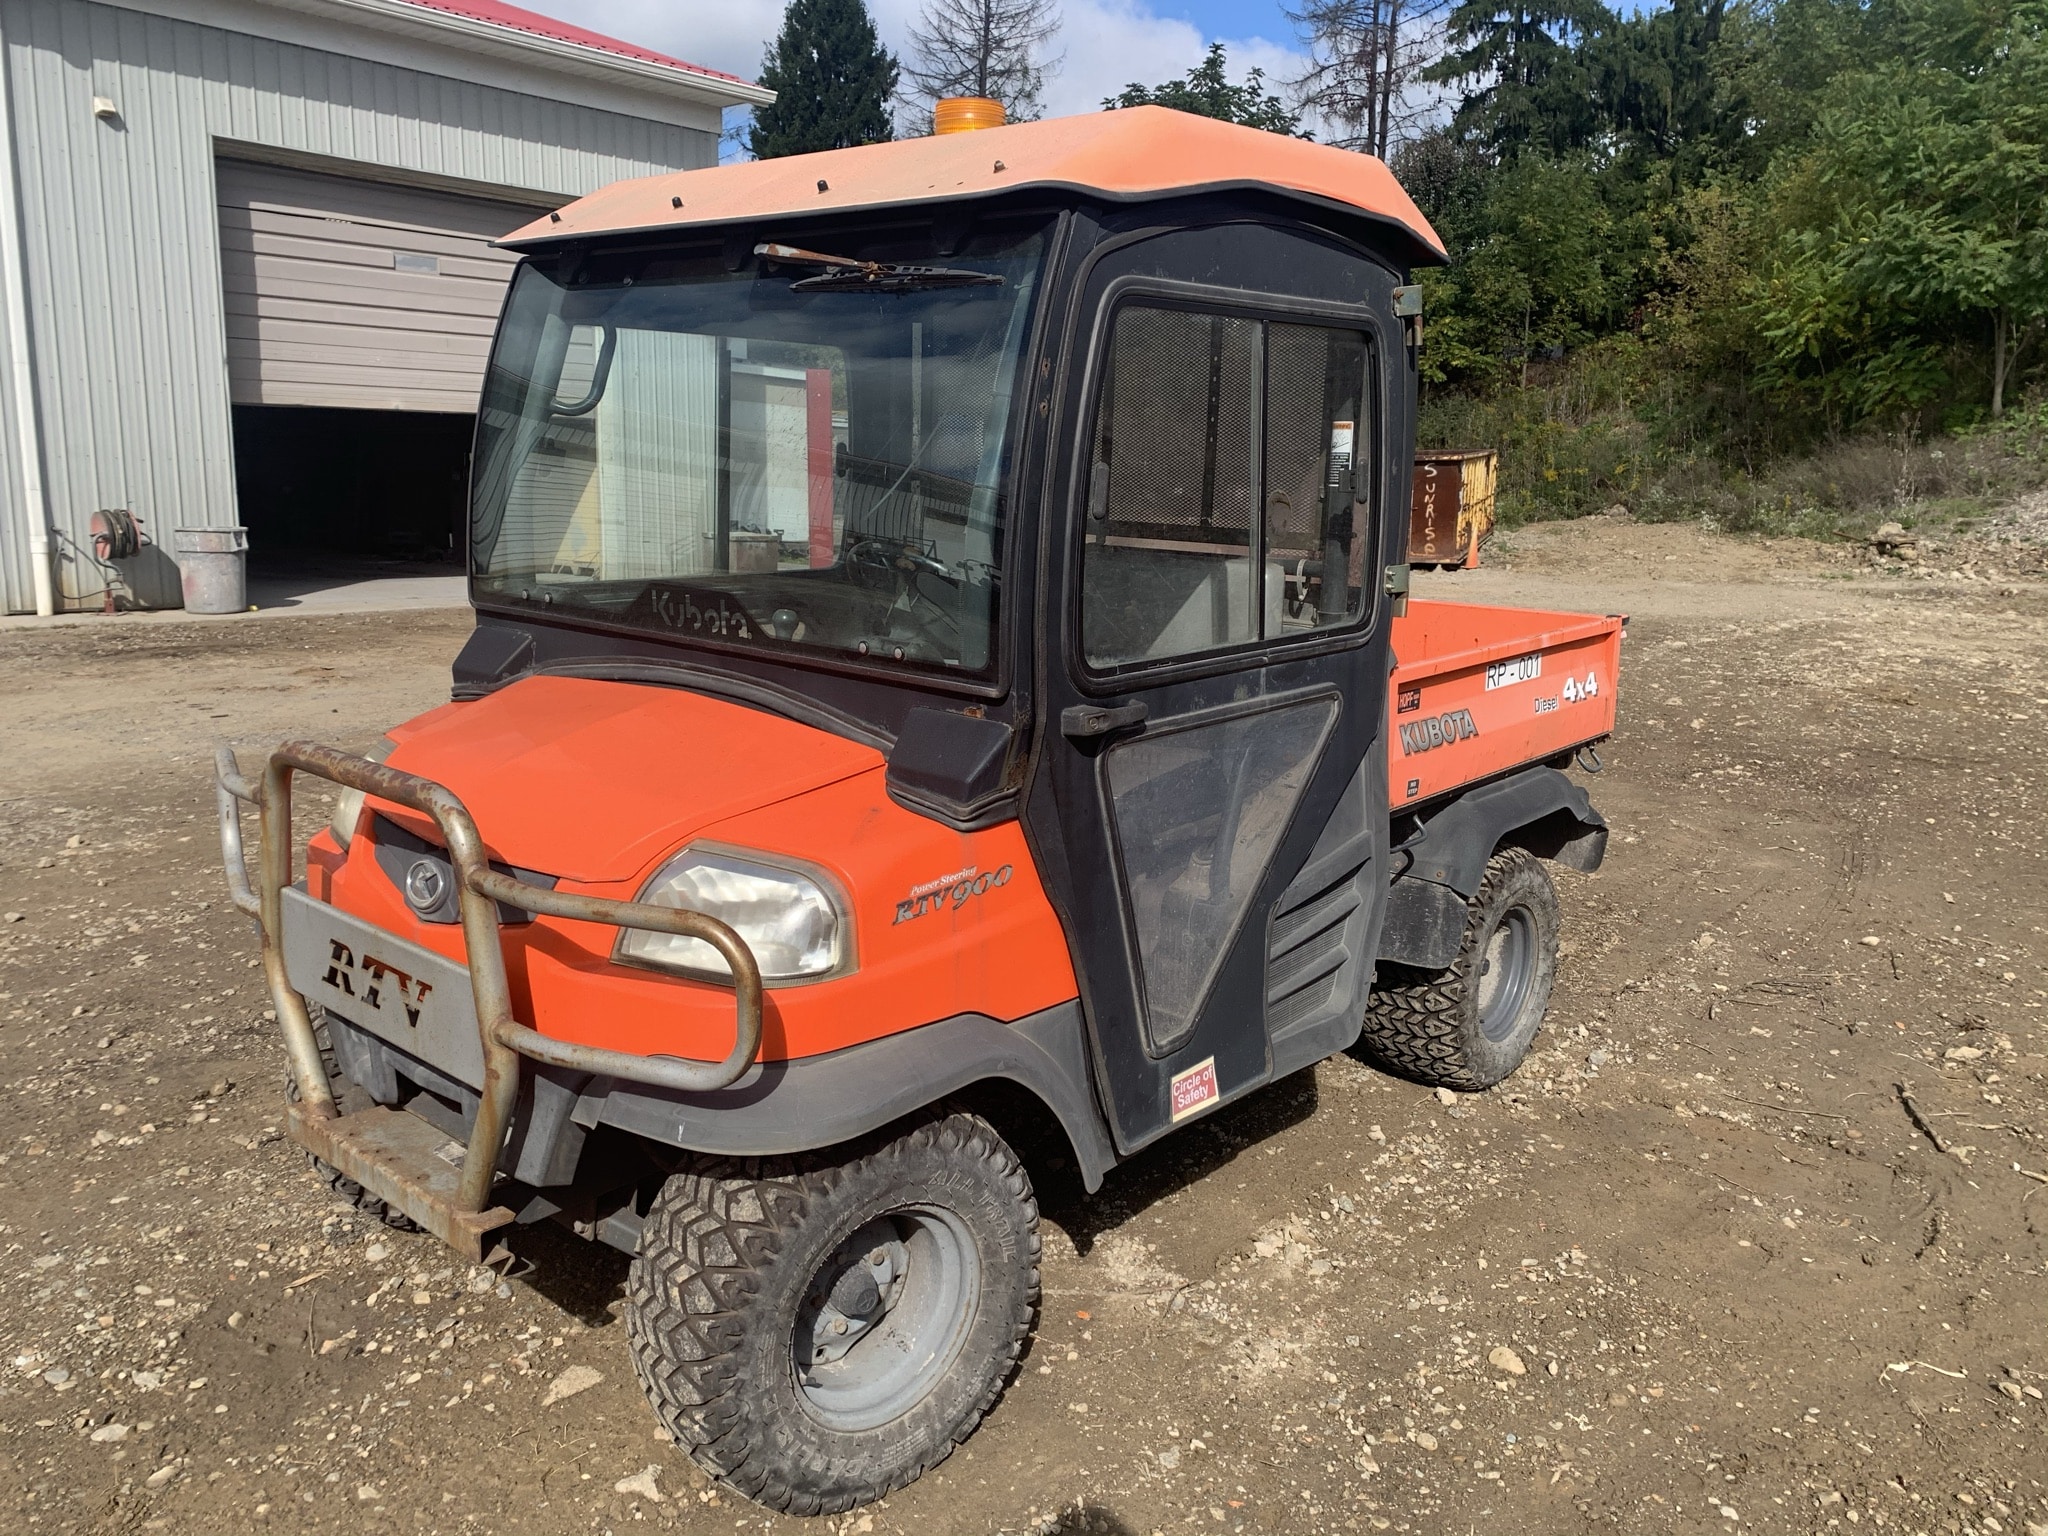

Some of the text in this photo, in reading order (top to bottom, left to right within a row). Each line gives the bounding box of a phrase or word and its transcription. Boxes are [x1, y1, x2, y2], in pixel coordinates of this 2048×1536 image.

[1486, 663, 1507, 689] RP
[1518, 655, 1540, 680] 001
[1563, 671, 1597, 703] 4x4
[1534, 694, 1558, 714] Diesel
[1399, 708, 1479, 756] KUBOTA
[892, 864, 1013, 926] RTV900
[911, 865, 977, 897] Power Steering
[322, 938, 432, 1028] RTV
[1173, 1066, 1213, 1096] Circle of
[1177, 1085, 1209, 1108] Safety
